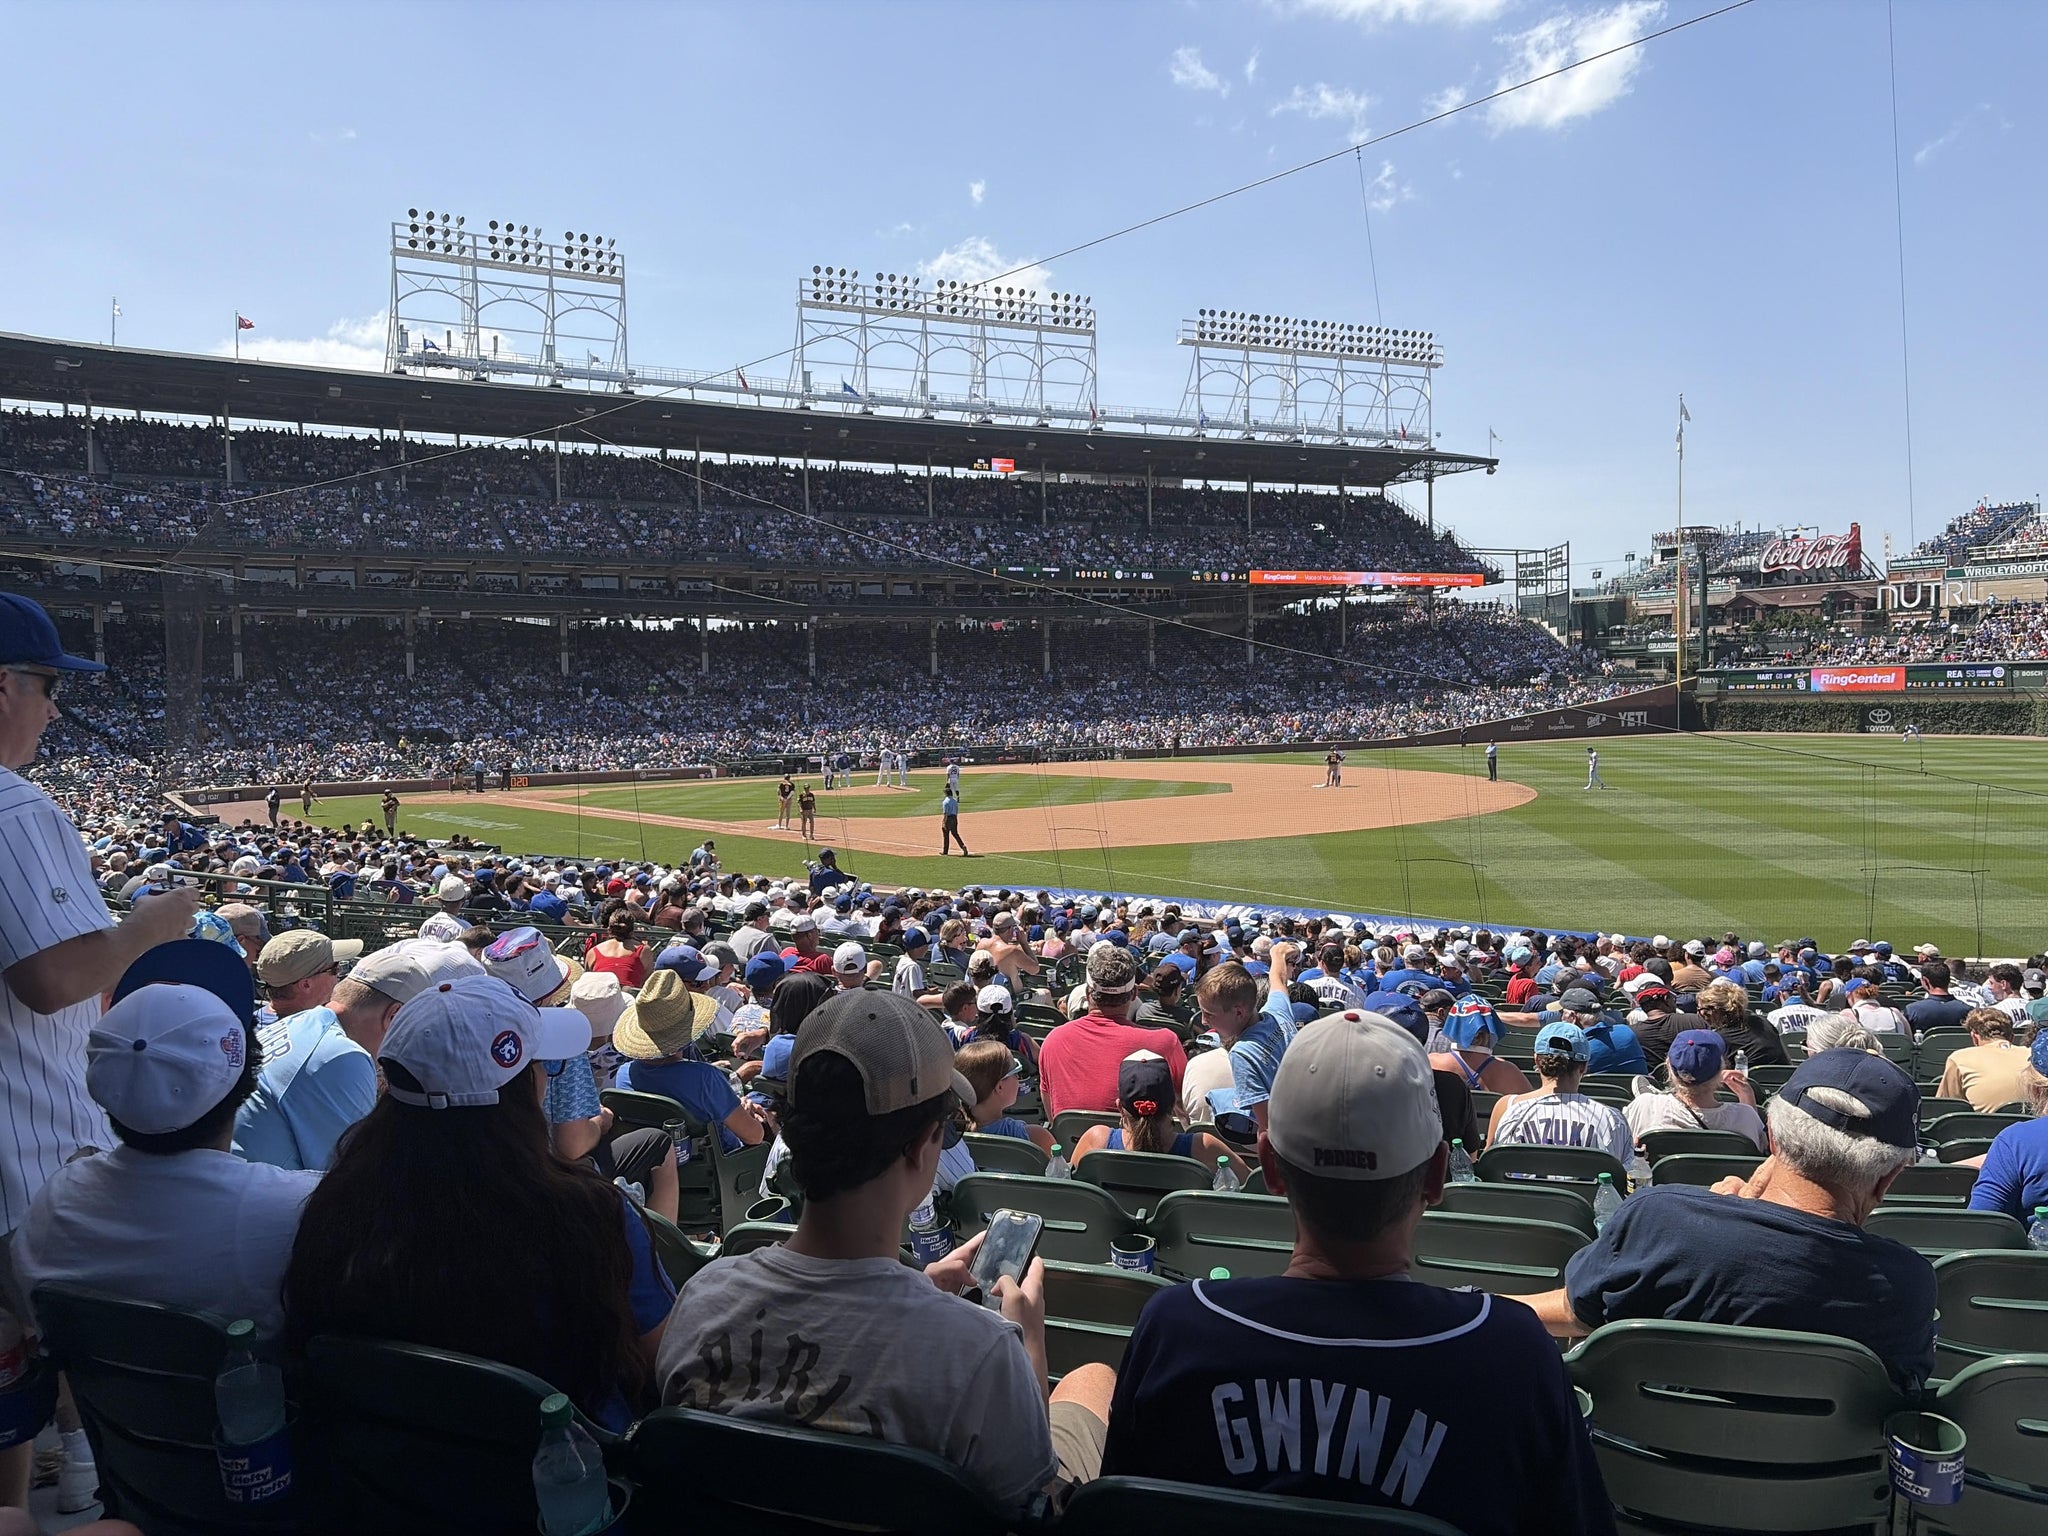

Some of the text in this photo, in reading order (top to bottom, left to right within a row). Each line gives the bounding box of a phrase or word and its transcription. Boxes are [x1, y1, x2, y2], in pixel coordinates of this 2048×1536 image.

[1141, 572, 1154, 580] REA
[1263, 573, 1297, 581] RingCentral
[1648, 642, 1678, 650] GRAINGE
[1820, 672, 1896, 686] RingCentral
[1946, 670, 1963, 679] REA
[1618, 711, 1648, 727] YETI
[1316, 985, 1348, 1001] UCKER
[1313, 1147, 1378, 1171] PADRES
[1211, 1378, 1448, 1507] GWYNN
[1898, 1477, 1928, 1496] Hefty
